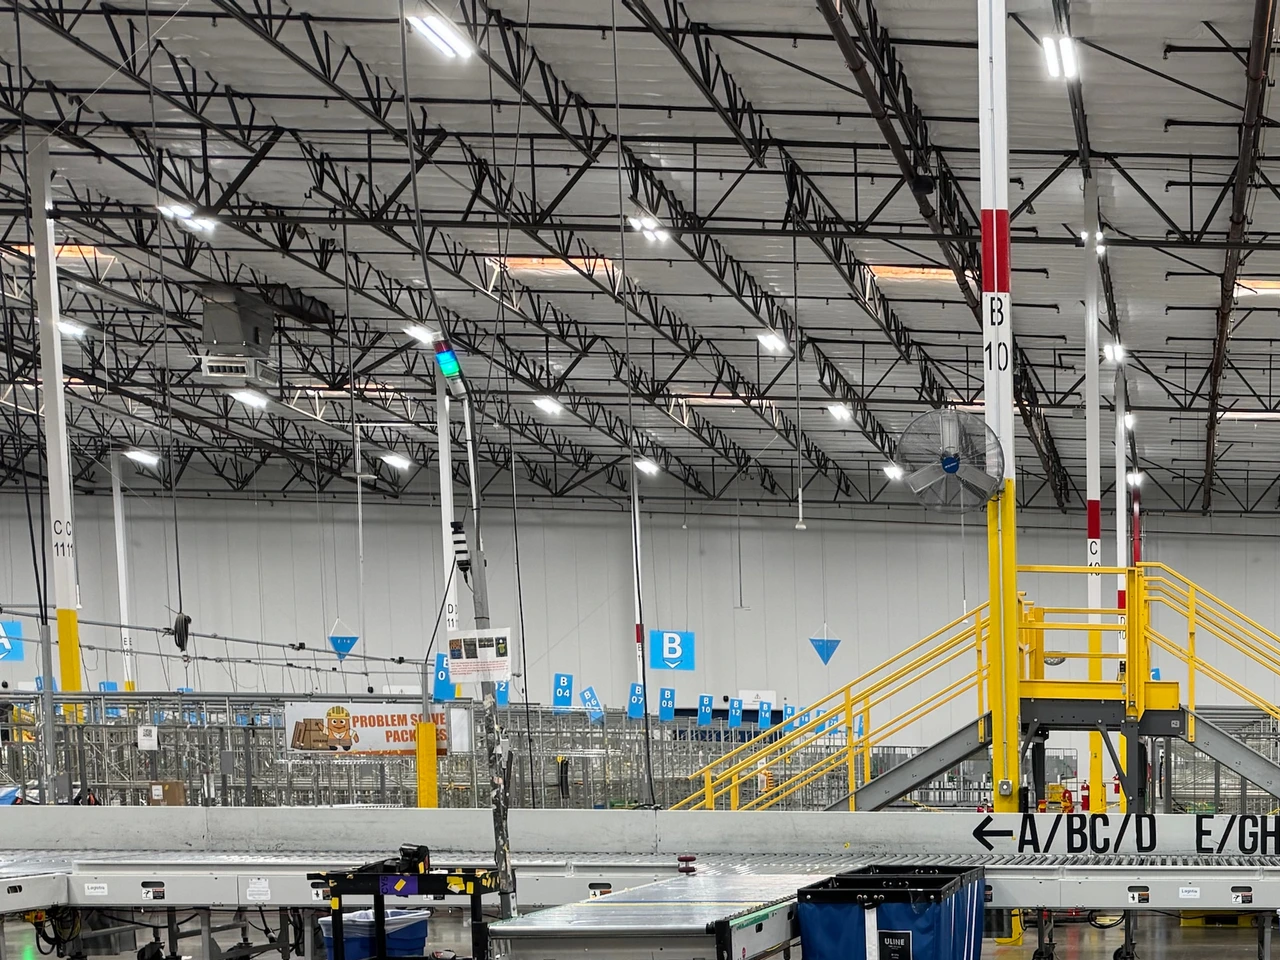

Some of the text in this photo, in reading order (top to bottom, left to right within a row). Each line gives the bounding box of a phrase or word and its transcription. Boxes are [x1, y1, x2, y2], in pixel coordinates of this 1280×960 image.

[990, 296, 1004, 326] B
[985, 341, 1008, 371] 10
[53, 520, 63, 535] C
[54, 542, 66, 557] 11
[1089, 540, 1098, 555] C
[447, 603, 454, 614] D
[663, 632, 683, 659] B
[560, 676, 568, 686] B
[556, 688, 570, 698] 04
[635, 685, 642, 695] B
[664, 690, 671, 699] B
[631, 696, 643, 705] 07
[661, 699, 673, 708] 08
[703, 696, 710, 705] B
[733, 700, 739, 708] B
[352, 712, 446, 728] PROBLEM SOVE
[385, 728, 448, 742] PACKES
[1018, 814, 1157, 854] A/BC/D
[884, 937, 905, 946] ULINE
